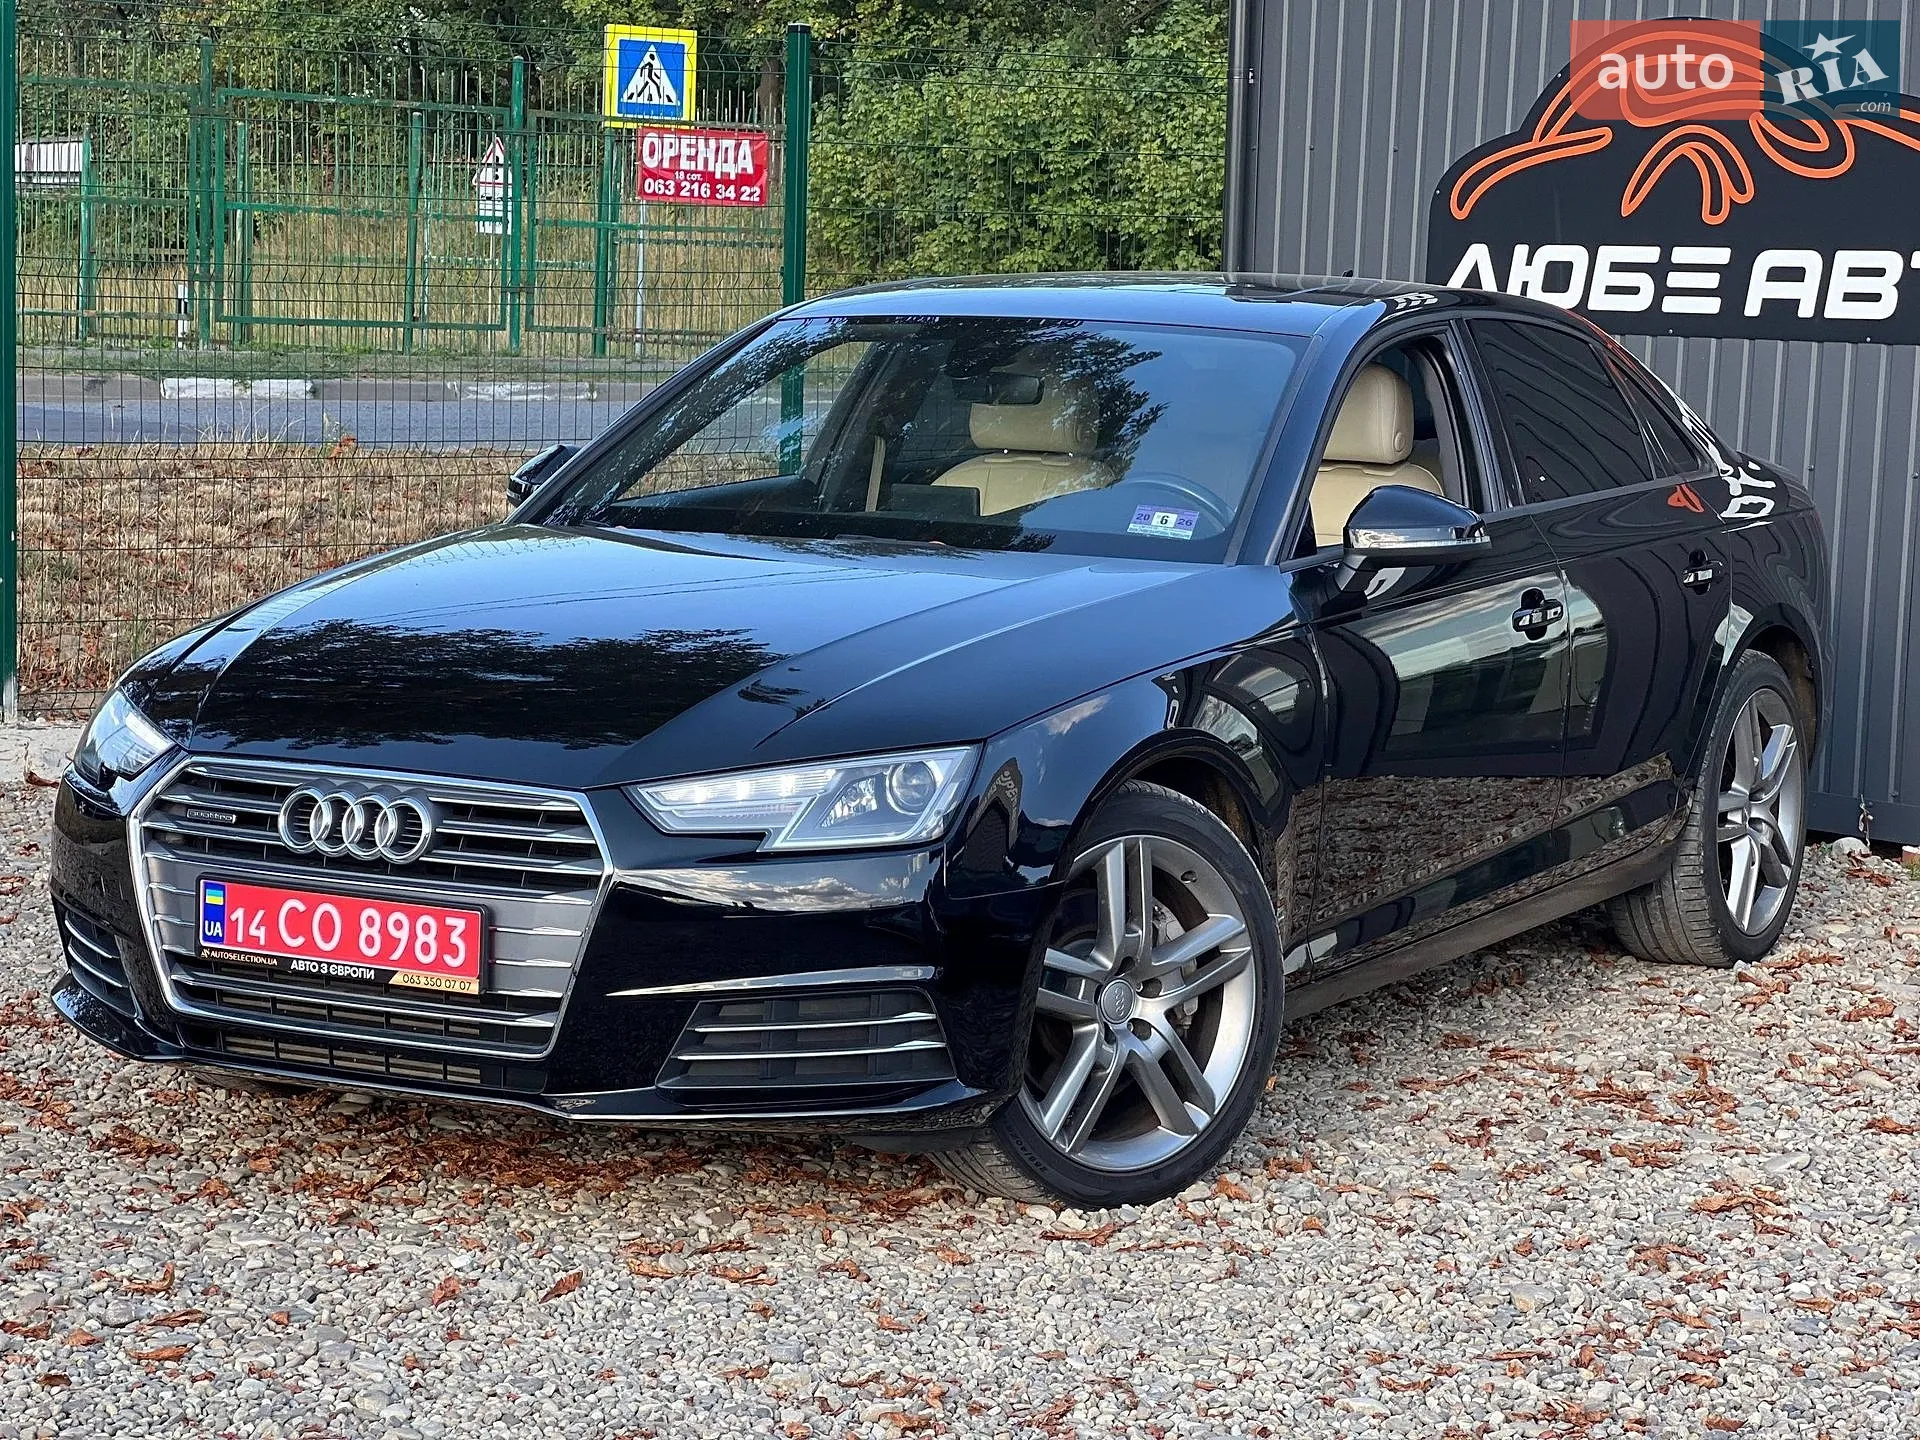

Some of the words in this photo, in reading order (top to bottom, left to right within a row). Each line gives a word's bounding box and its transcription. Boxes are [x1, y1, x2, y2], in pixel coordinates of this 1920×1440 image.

[642, 132, 754, 180] ОРЕНДА
[675, 171, 684, 180] 18
[644, 178, 675, 195] 063
[680, 182, 711, 198] 216
[716, 184, 736, 200] 34
[740, 186, 761, 202] 22
[1446, 243, 1732, 314] ЛЮБЕ
[1744, 249, 1920, 320] АВ
[1136, 513, 1150, 521] 20
[1160, 515, 1169, 525] 6
[1177, 518, 1192, 526] 26
[205, 920, 222, 937] UA
[229, 907, 266, 946] 14
[278, 898, 342, 952] CO
[358, 907, 466, 968] 8983
[210, 950, 278, 966] AUTOSELECTION.UA
[290, 960, 319, 973] АВТО
[329, 965, 375, 980] ЄВРОПИ
[402, 974, 421, 985] 063
[424, 975, 442, 987] 350
[444, 979, 456, 989] 07
[460, 980, 471, 991] 07
